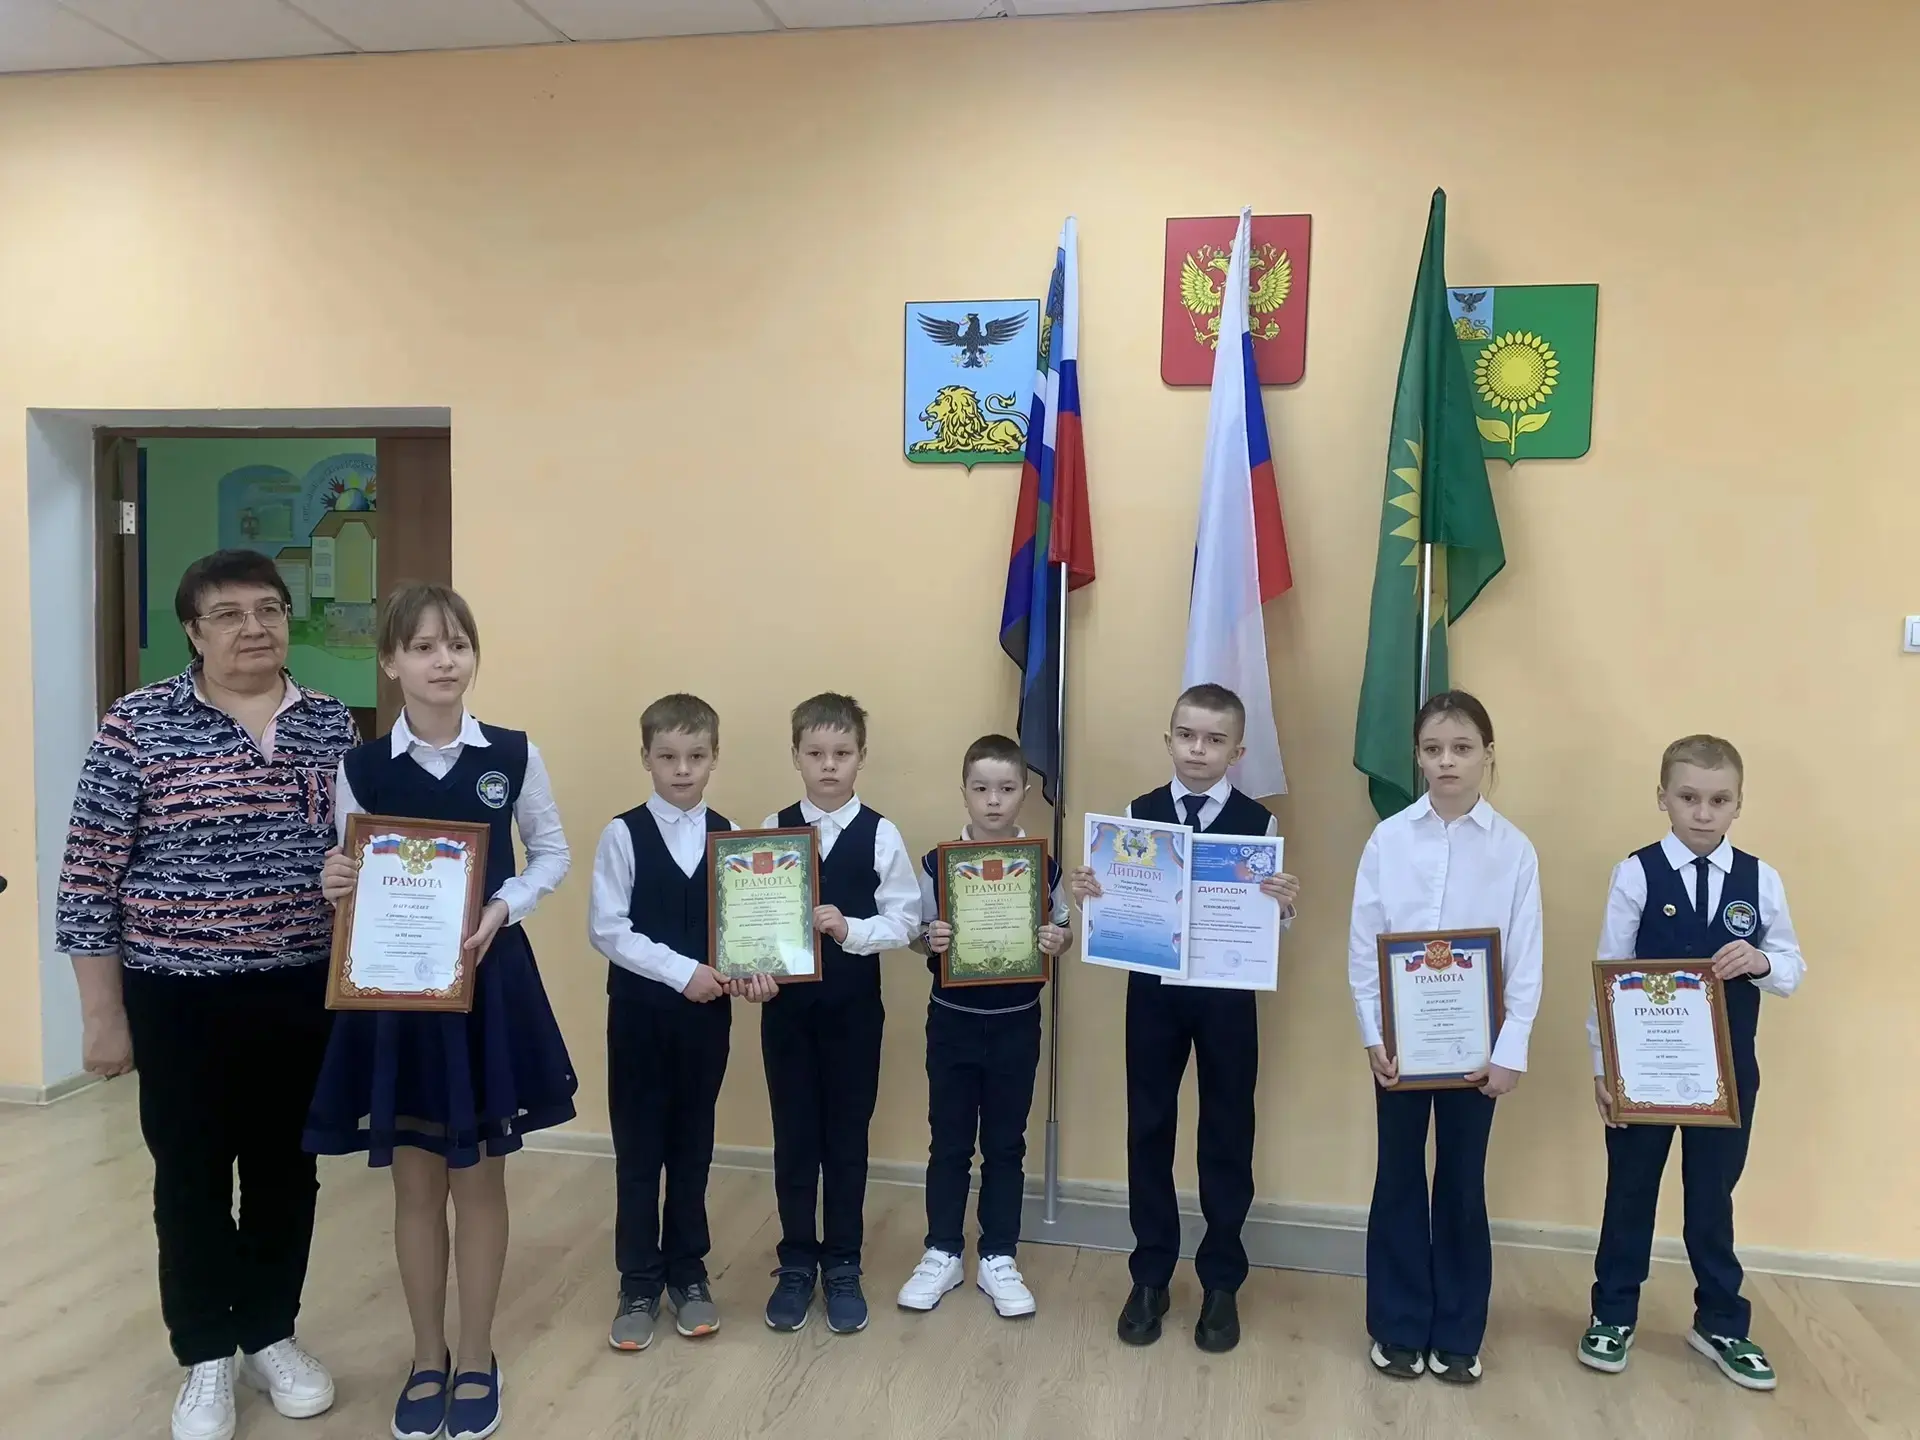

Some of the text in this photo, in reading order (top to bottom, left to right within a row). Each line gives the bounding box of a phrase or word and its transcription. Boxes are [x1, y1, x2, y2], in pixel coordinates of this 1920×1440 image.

[382, 876, 443, 889] ГРАМОТА
[734, 876, 793, 888] ГРАМОТА
[965, 882, 1022, 894] ГРАМОТА
[1197, 886, 1248, 895] ДИПЛОМ
[1415, 973, 1465, 984] ГРАМОТА
[1634, 1007, 1690, 1016] ГРАМОТА
